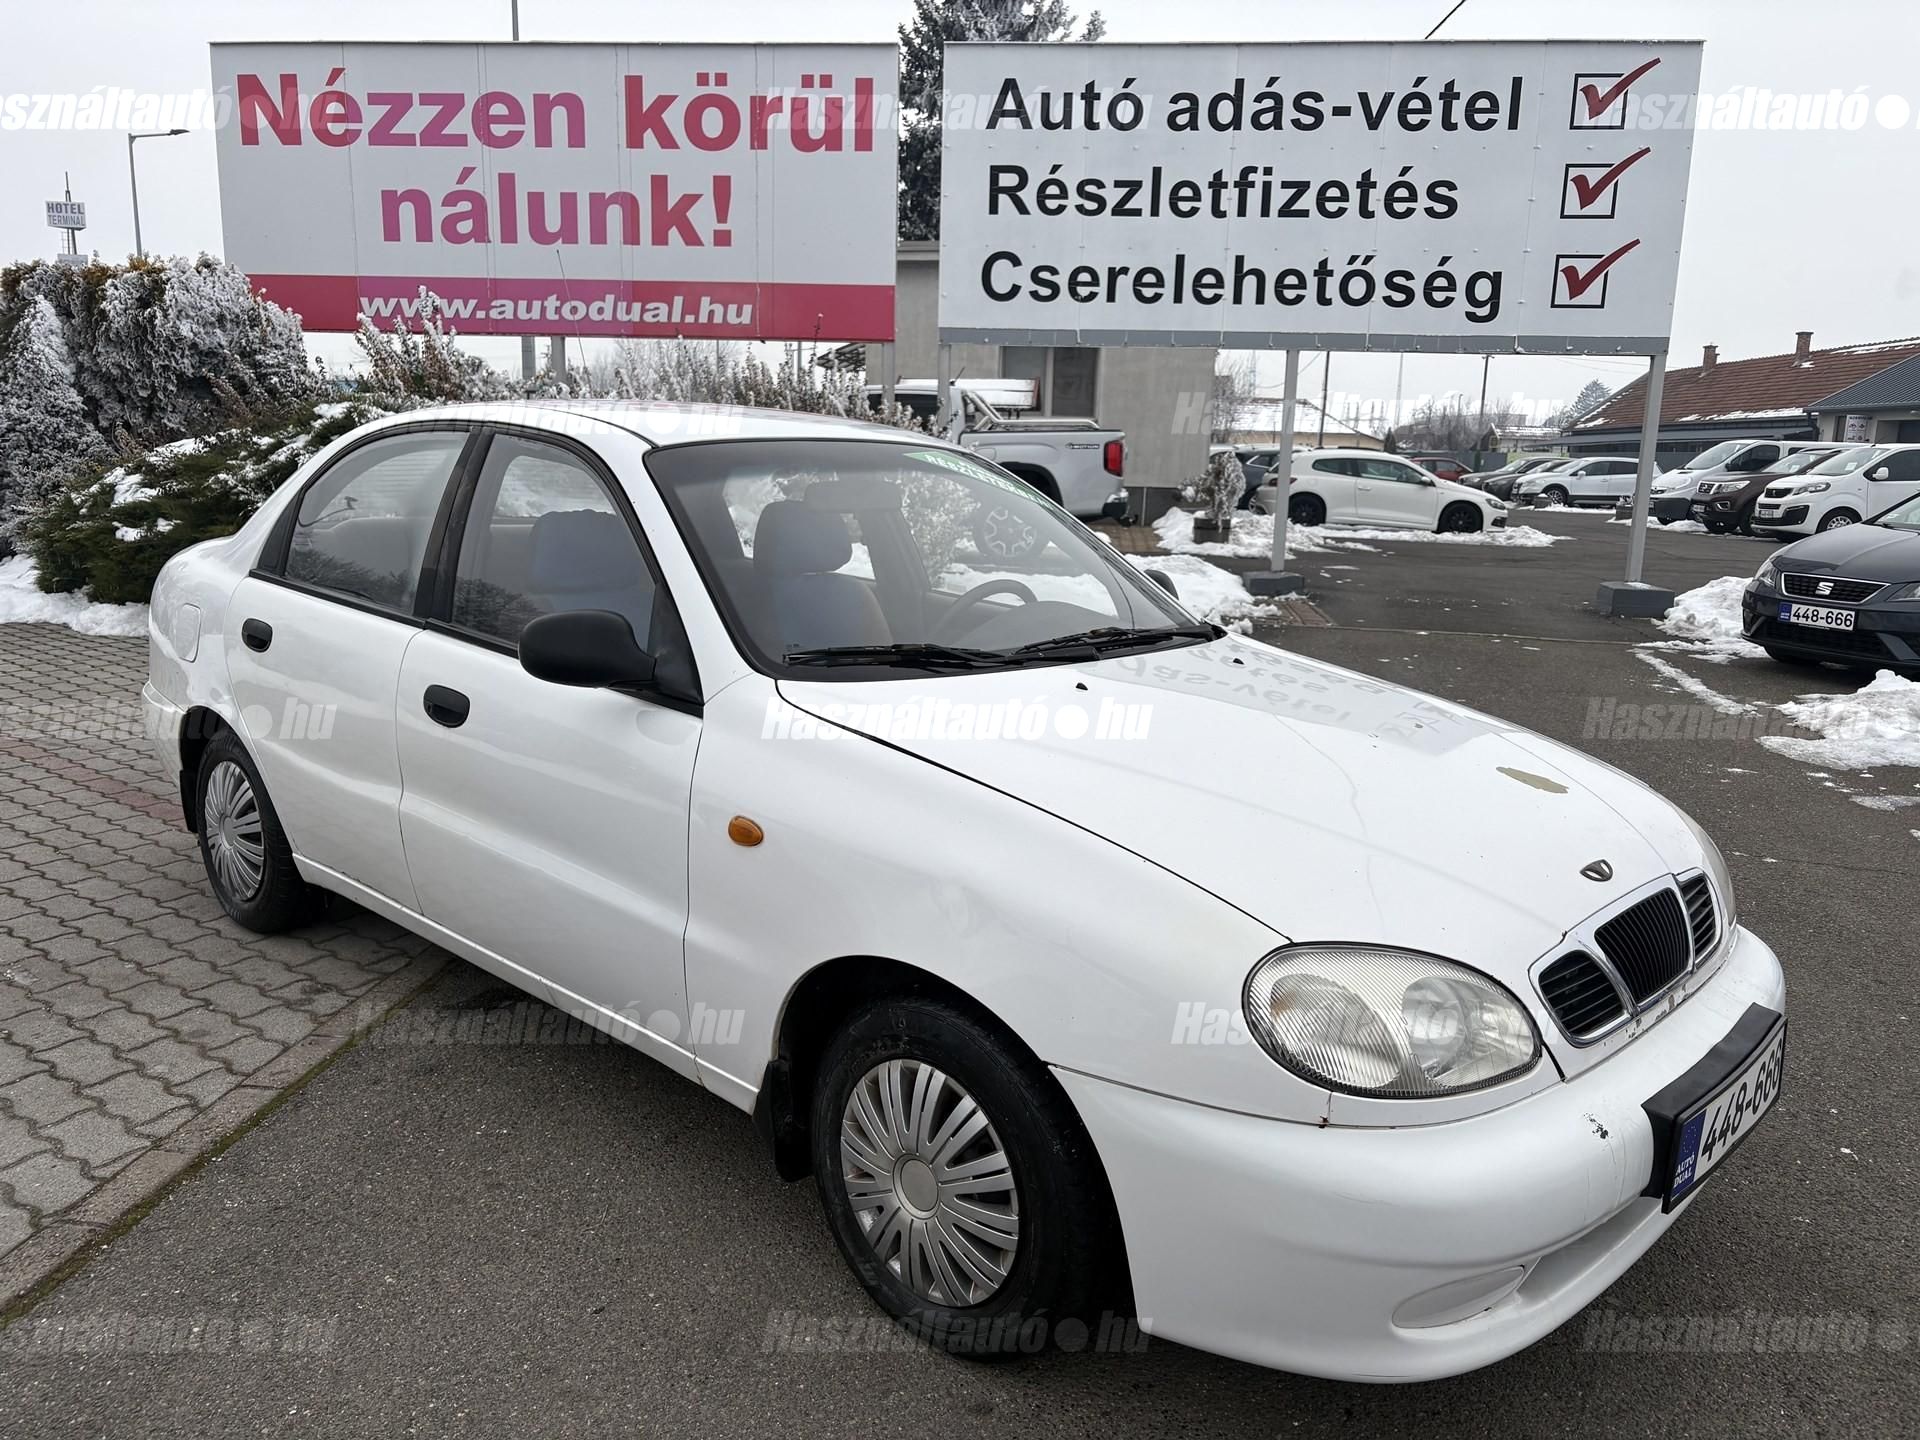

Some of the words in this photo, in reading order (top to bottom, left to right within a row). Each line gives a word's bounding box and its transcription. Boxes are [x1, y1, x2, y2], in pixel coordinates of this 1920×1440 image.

[236, 68, 585, 149] Nézzen
[624, 72, 874, 153] körül
[985, 77, 1144, 132] Autó
[1167, 76, 1522, 132] adás-vétel
[47, 203, 84, 214] HOTEL
[380, 167, 733, 247] nálunk!
[988, 164, 1458, 219] Részletfizetés
[48, 215, 85, 226] TERMINAL
[981, 251, 1503, 323] Cserelehetőség
[360, 294, 753, 325] www.autodual.hu
[1793, 606, 1853, 627] 448-666
[1701, 1038, 1782, 1162] 448-666
[1674, 1170, 1693, 1187] DUAL
[1677, 1153, 1695, 1174] AUTÓ
